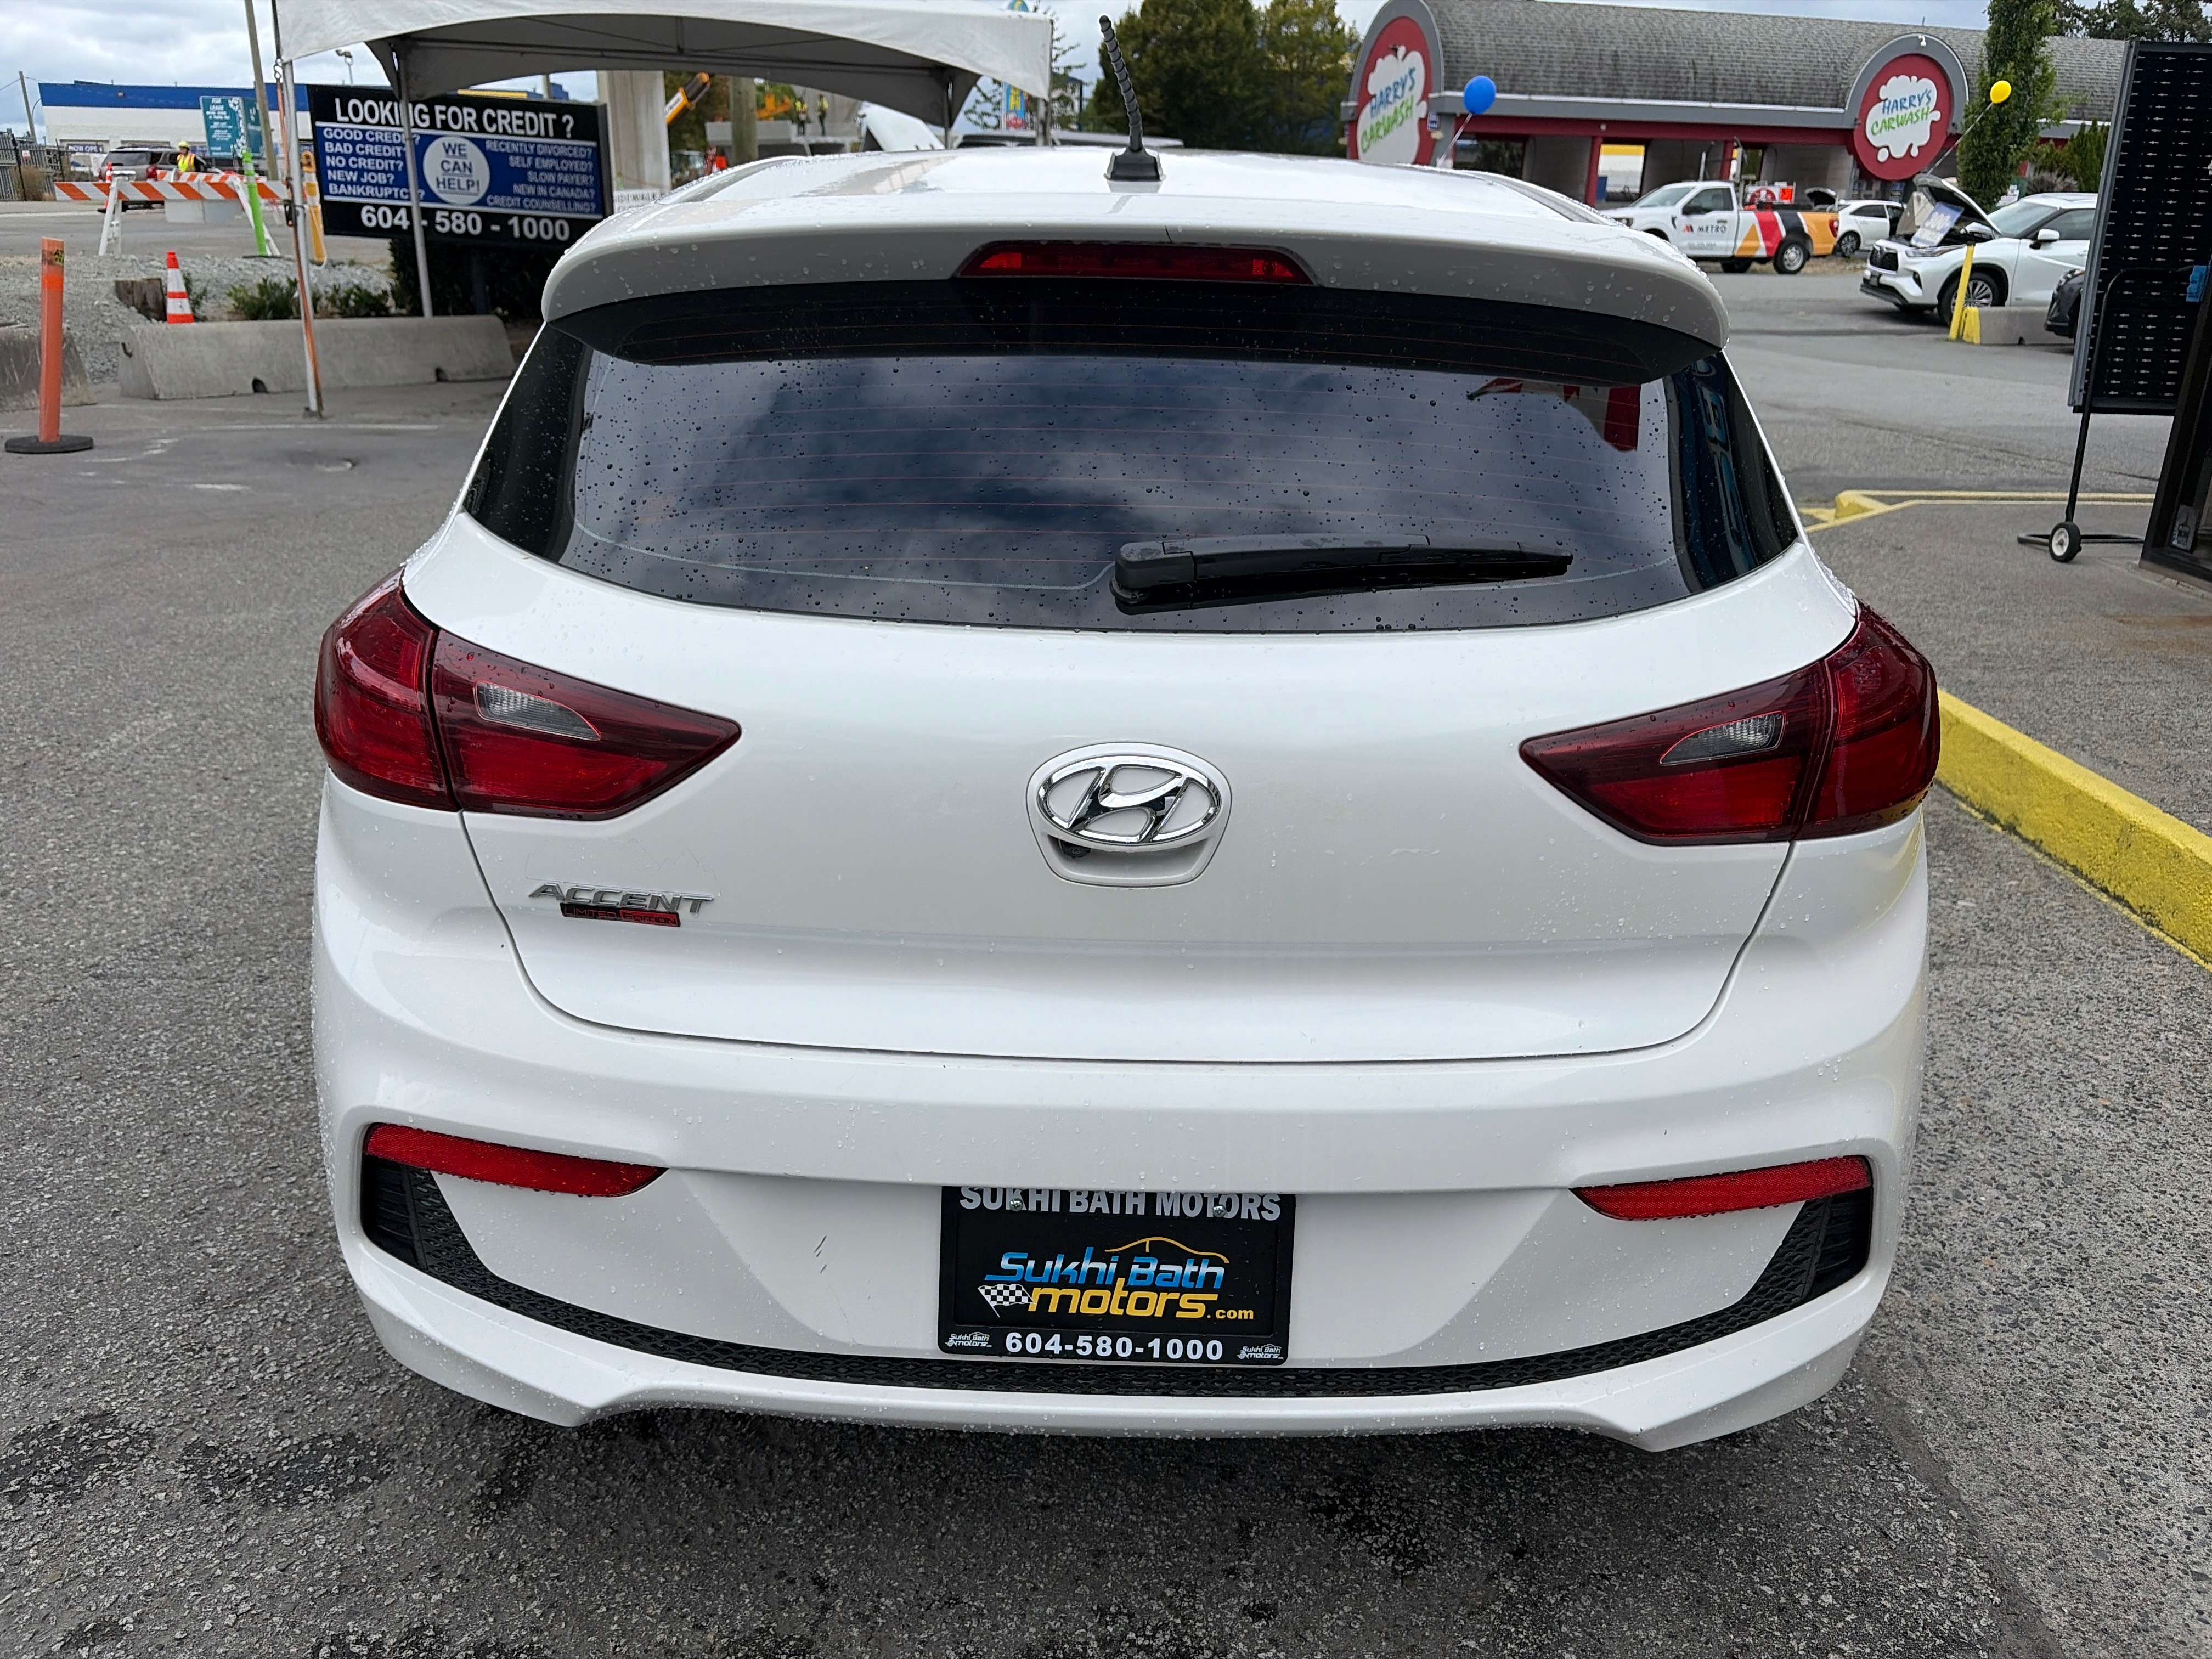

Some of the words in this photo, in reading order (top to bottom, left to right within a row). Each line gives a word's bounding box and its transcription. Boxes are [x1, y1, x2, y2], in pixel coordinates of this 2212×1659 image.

[1882, 88, 1932, 114] HARRY'S
[435, 104, 479, 132] FOR
[482, 108, 557, 137] CREDIT
[1361, 95, 1414, 153] CARWASH
[1871, 106, 1930, 136] CARWASH
[323, 128, 363, 141] GOOD
[324, 142, 353, 154] BAD
[356, 144, 406, 157] CREDIT
[442, 142, 466, 155] WE
[486, 140, 535, 154] RECENTLY
[326, 155, 346, 167] NO
[348, 157, 403, 171] CREDIT?
[441, 160, 472, 173] CAN
[509, 155, 533, 168] SELF
[328, 169, 358, 182] NEW
[360, 172, 395, 184] JOB?
[436, 176, 480, 192] HELP!
[527, 170, 556, 183] SLOW
[557, 173, 594, 185] PAYER?
[329, 183, 425, 200] BANKRUPTC?
[513, 183, 535, 195] NEW
[537, 185, 548, 196] IN
[549, 186, 595, 199] CANADA?
[486, 195, 521, 207] CREDIT
[360, 205, 410, 230] 604
[435, 210, 482, 235] 580
[507, 216, 570, 241] 1000
[1697, 225, 1726, 233] METRO
[528, 883, 714, 913] ACCENT
[564, 907, 617, 918] LIMITED
[623, 913, 676, 925] EDITION
[960, 1186, 1060, 1212] SUKHI
[1069, 1190, 1146, 1215] BATH
[1156, 1192, 1281, 1221] MOTORS
[985, 1247, 1119, 1285] Sukhi
[1128, 1256, 1224, 1289] Bath
[1006, 1332, 1223, 1360] 604-580-1000
